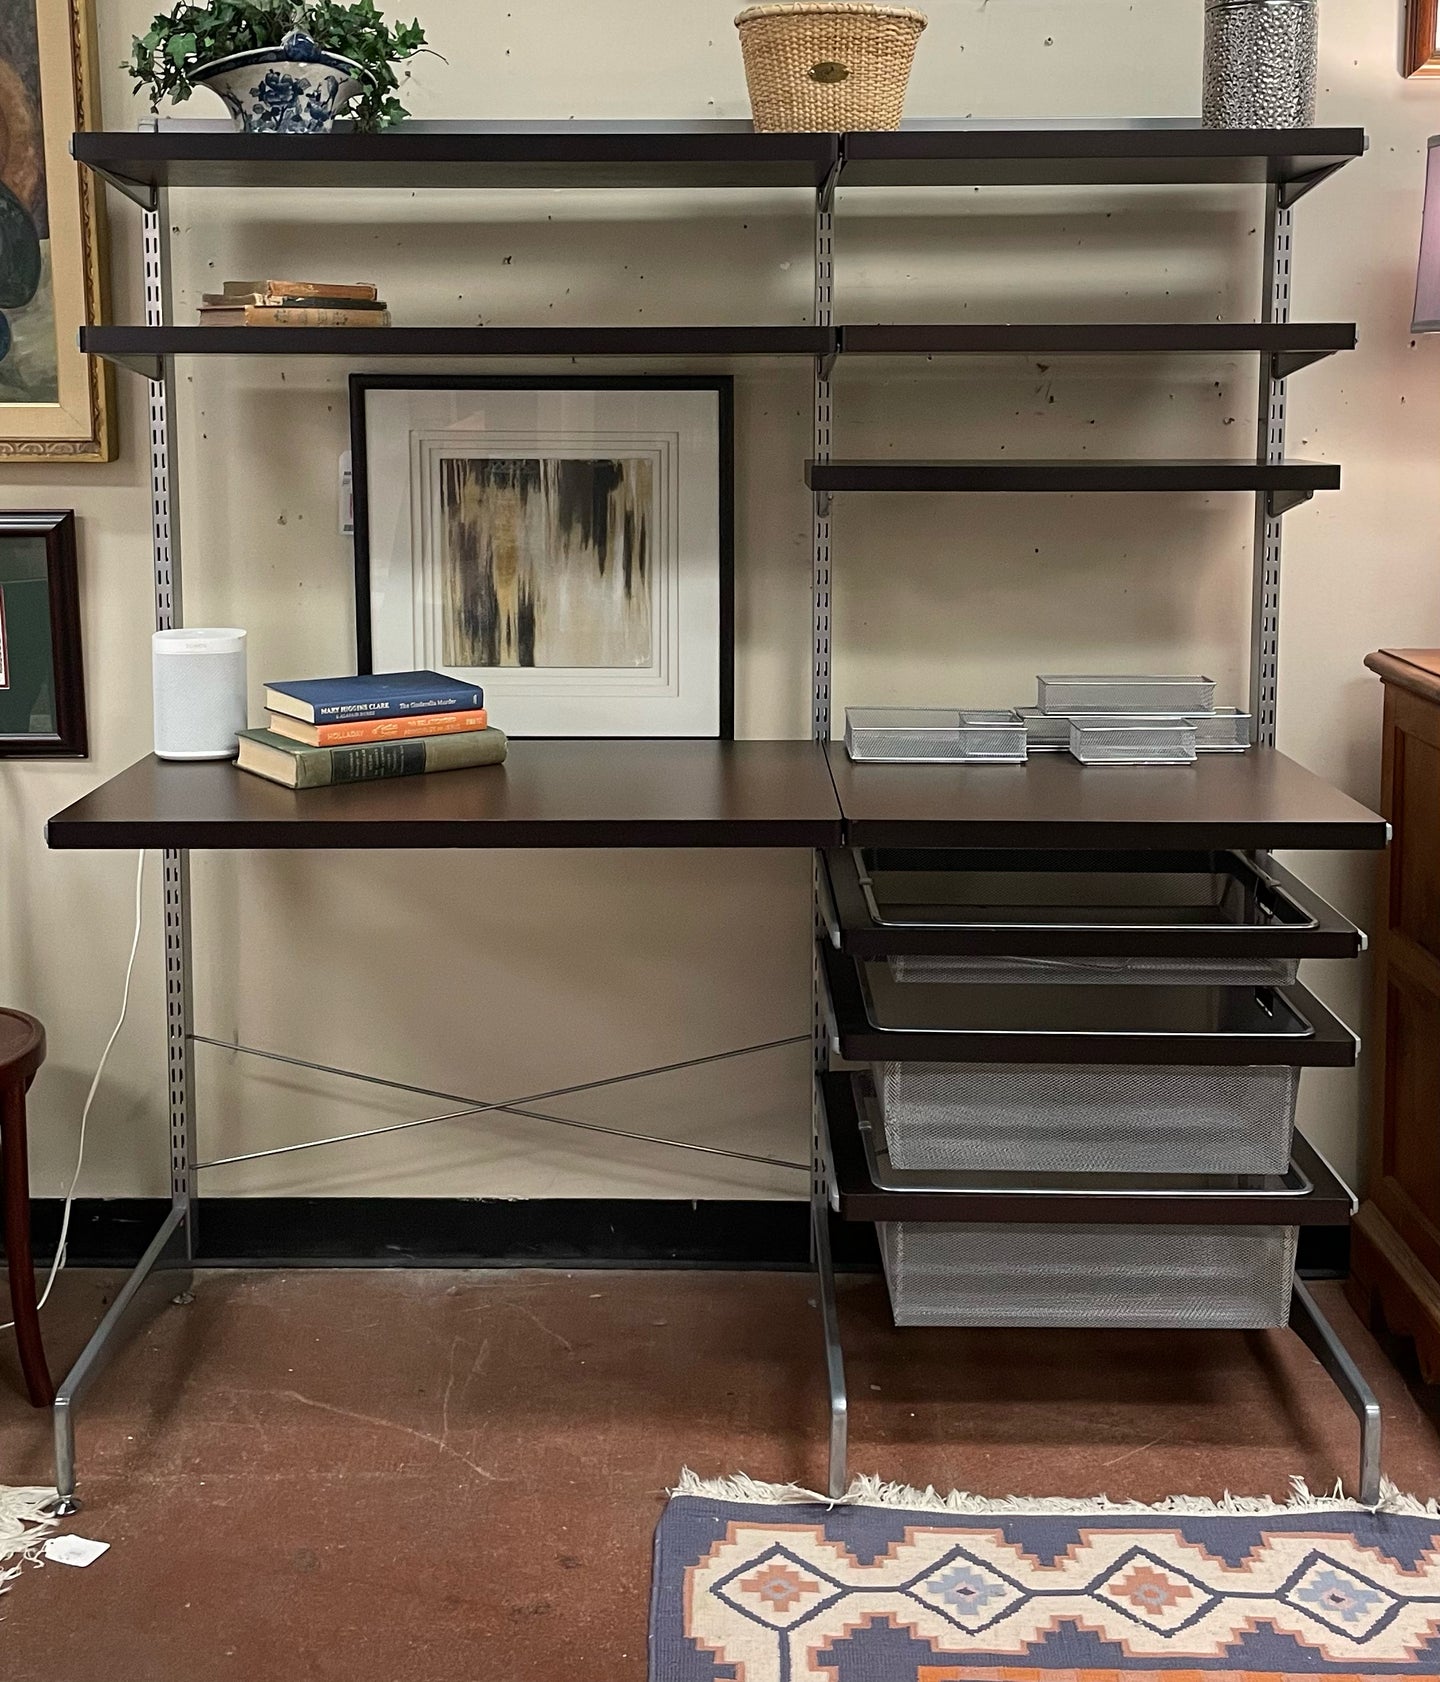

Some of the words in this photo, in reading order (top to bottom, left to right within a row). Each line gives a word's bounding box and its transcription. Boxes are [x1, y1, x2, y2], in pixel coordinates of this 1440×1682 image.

[321, 707, 340, 715] MARY
[369, 702, 390, 710] CLARK
[399, 702, 410, 710] The
[437, 698, 457, 706] Murder
